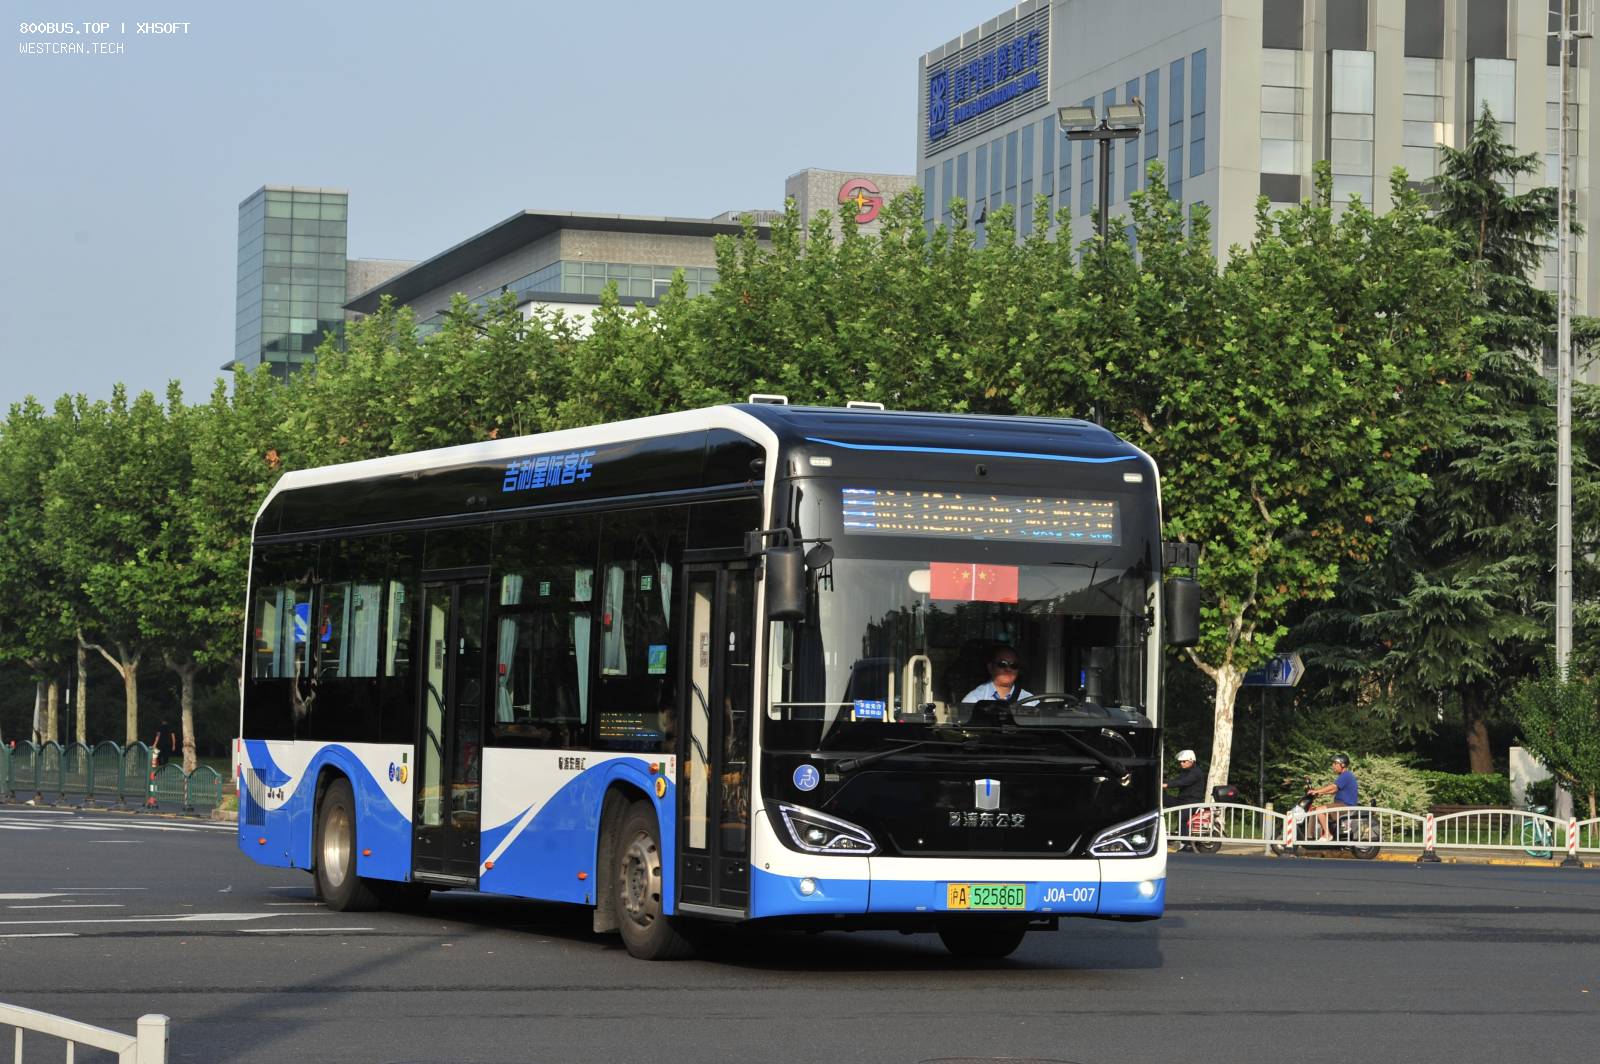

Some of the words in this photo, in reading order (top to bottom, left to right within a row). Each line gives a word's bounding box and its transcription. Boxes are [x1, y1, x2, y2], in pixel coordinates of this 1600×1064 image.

[502, 450, 596, 492] 吉利星际客车
